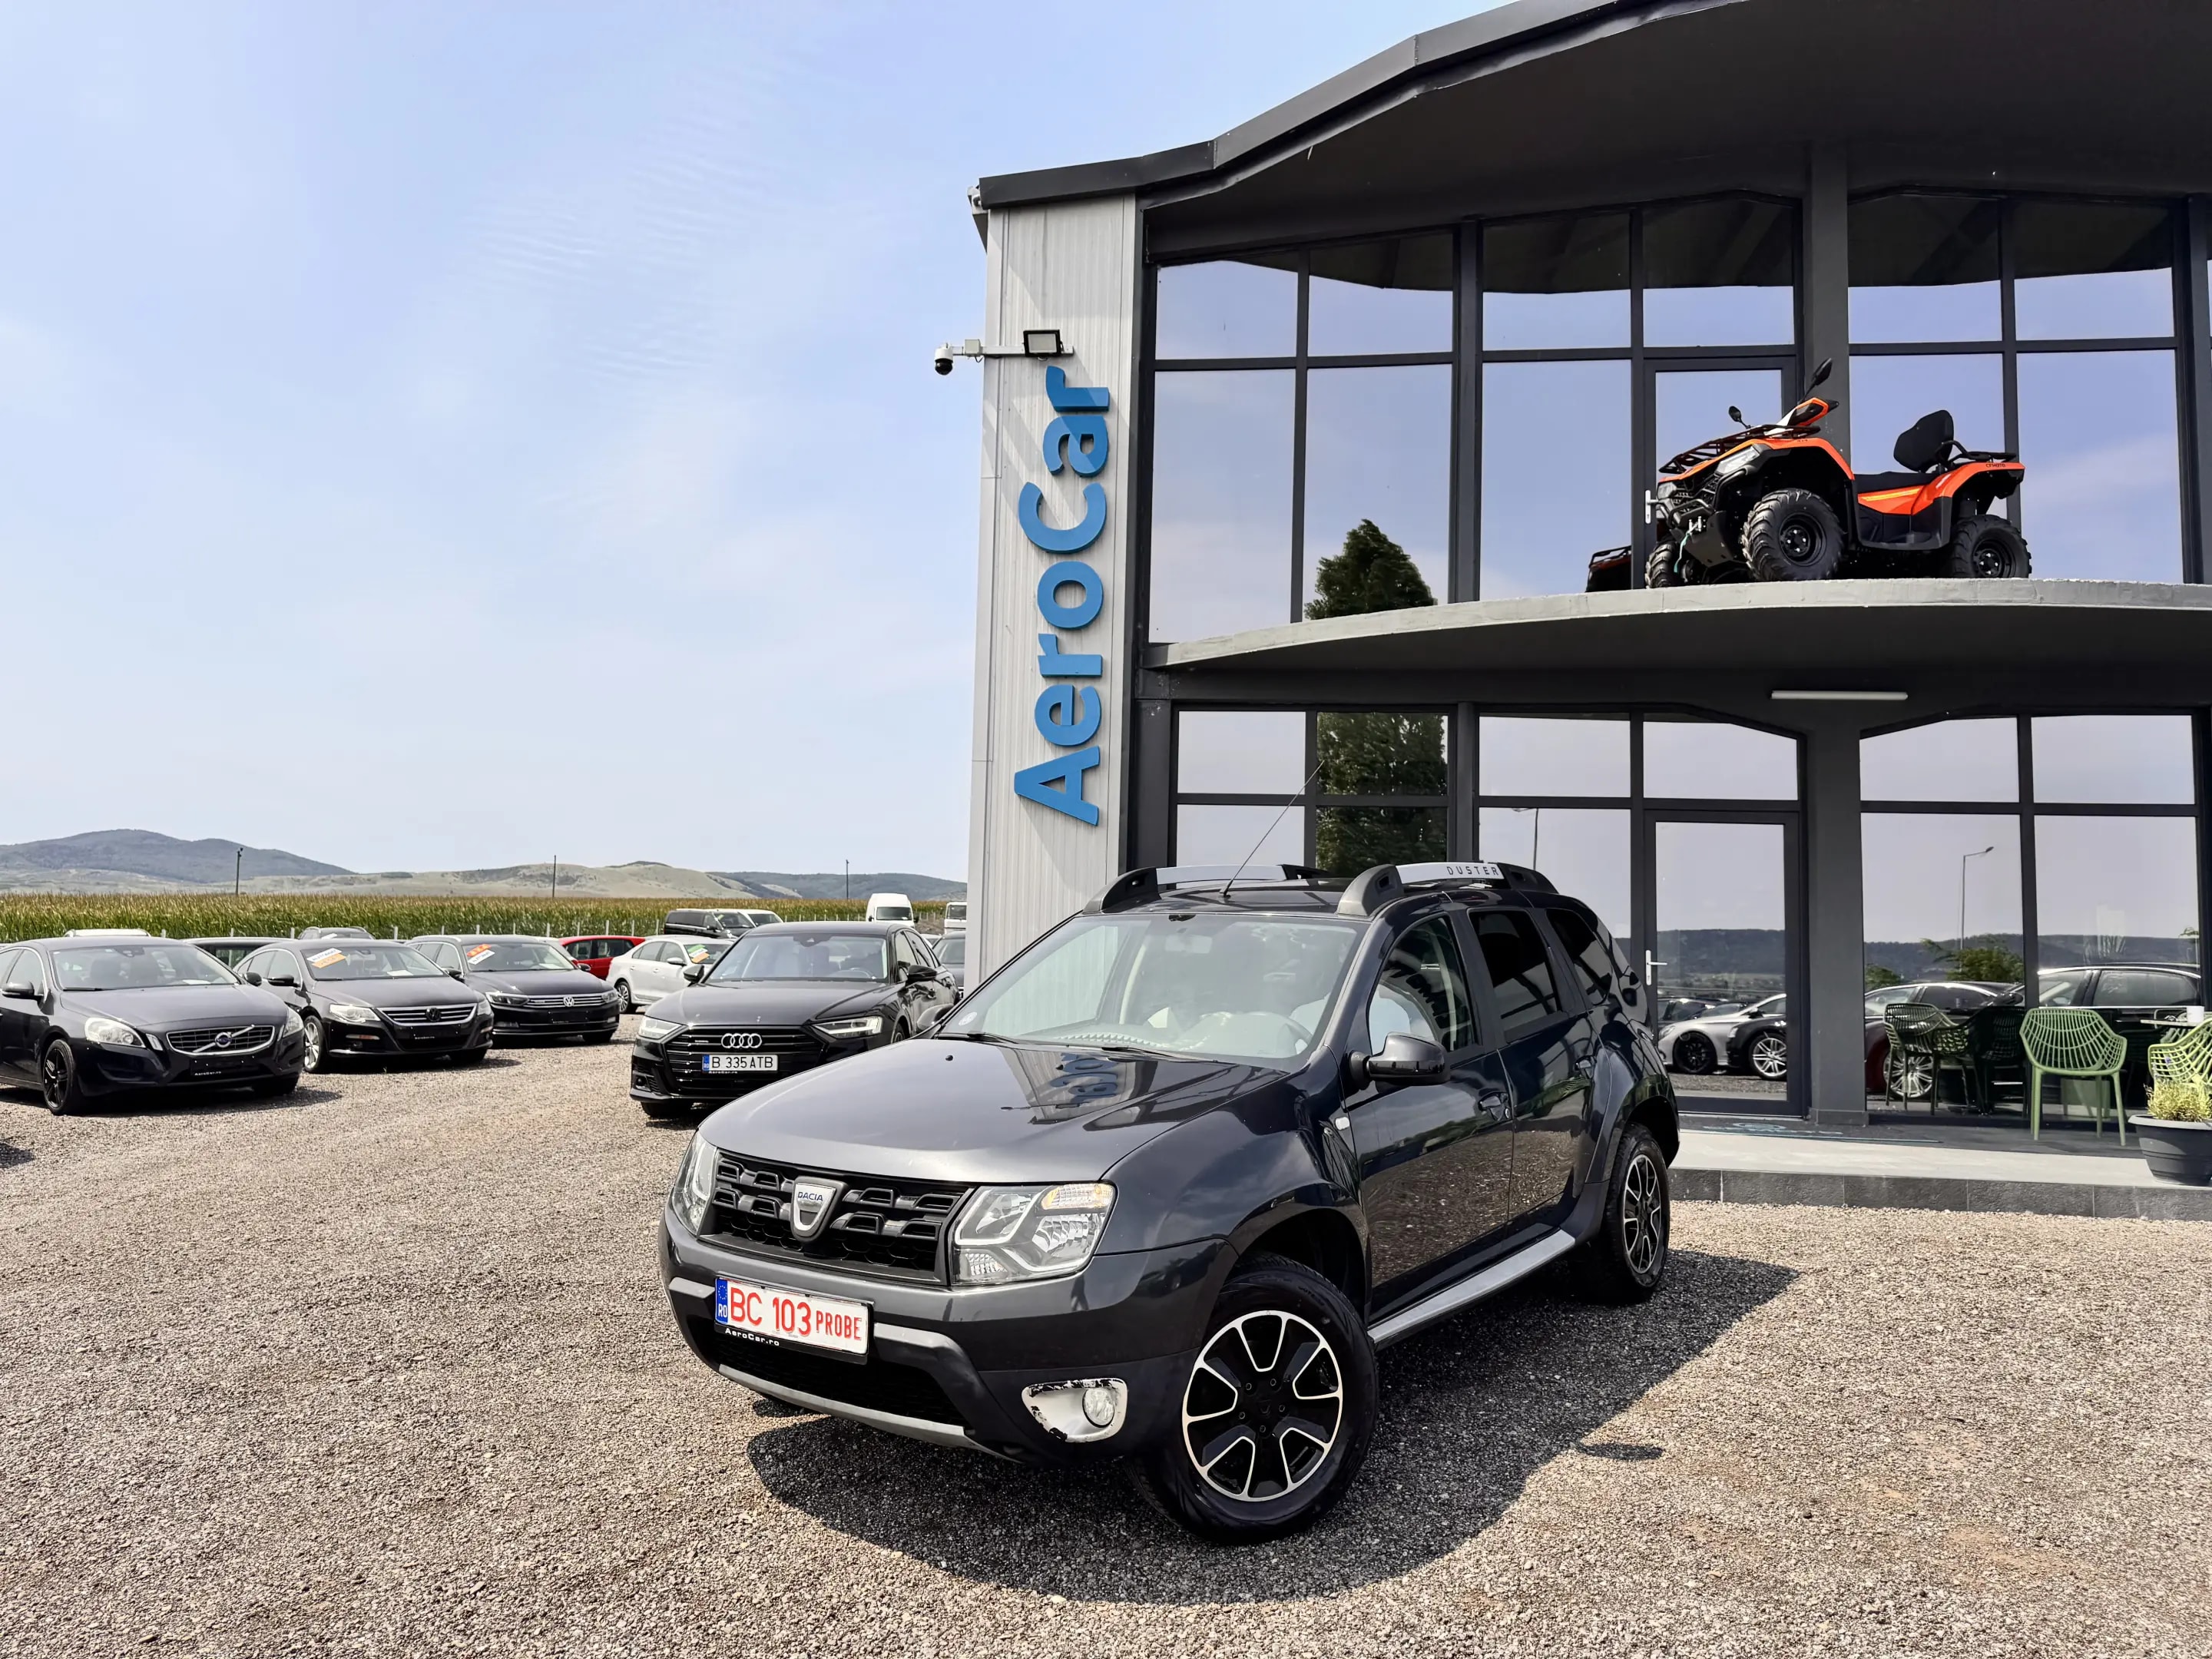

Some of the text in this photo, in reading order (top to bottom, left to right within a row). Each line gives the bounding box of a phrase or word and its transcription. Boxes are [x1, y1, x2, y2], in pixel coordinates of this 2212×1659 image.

[1014, 365, 1110, 826] AeroCar
[1446, 866, 1499, 876] DUSTER
[712, 1056, 773, 1068] B 335 ATB
[797, 1191, 823, 1202] DACIA
[718, 1303, 727, 1319] RO
[730, 1286, 863, 1341] BC 103 PROBE
[724, 1327, 780, 1346] AeroCar.ro
